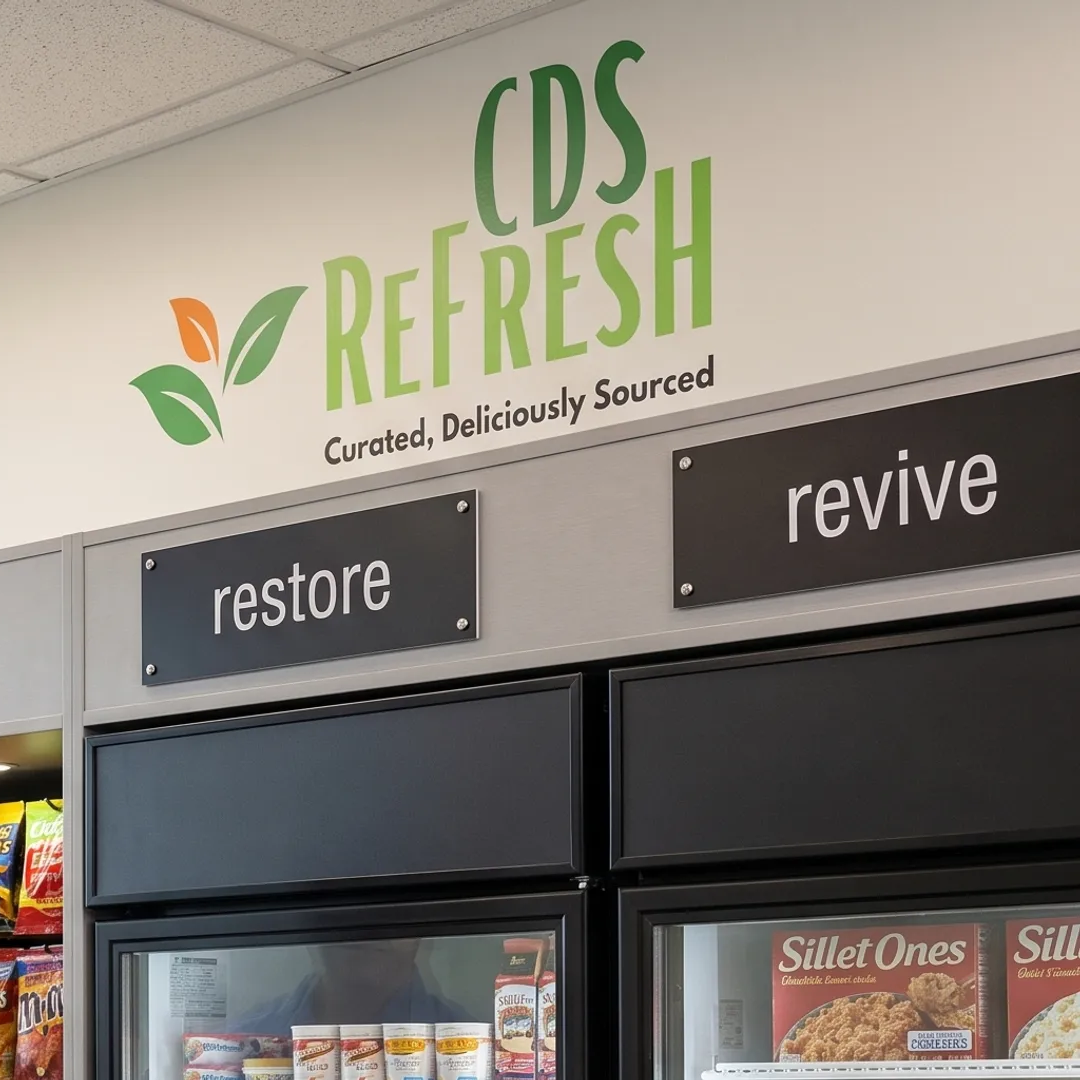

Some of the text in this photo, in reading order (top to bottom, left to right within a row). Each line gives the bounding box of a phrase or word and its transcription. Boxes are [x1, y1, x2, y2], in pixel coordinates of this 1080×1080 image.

[473, 39, 647, 237] CDS
[324, 354, 716, 466] Curated, Deliciously Sourced
[786, 449, 999, 544] revive
[212, 557, 392, 636] restore
[1013, 923, 1080, 964] Sill
